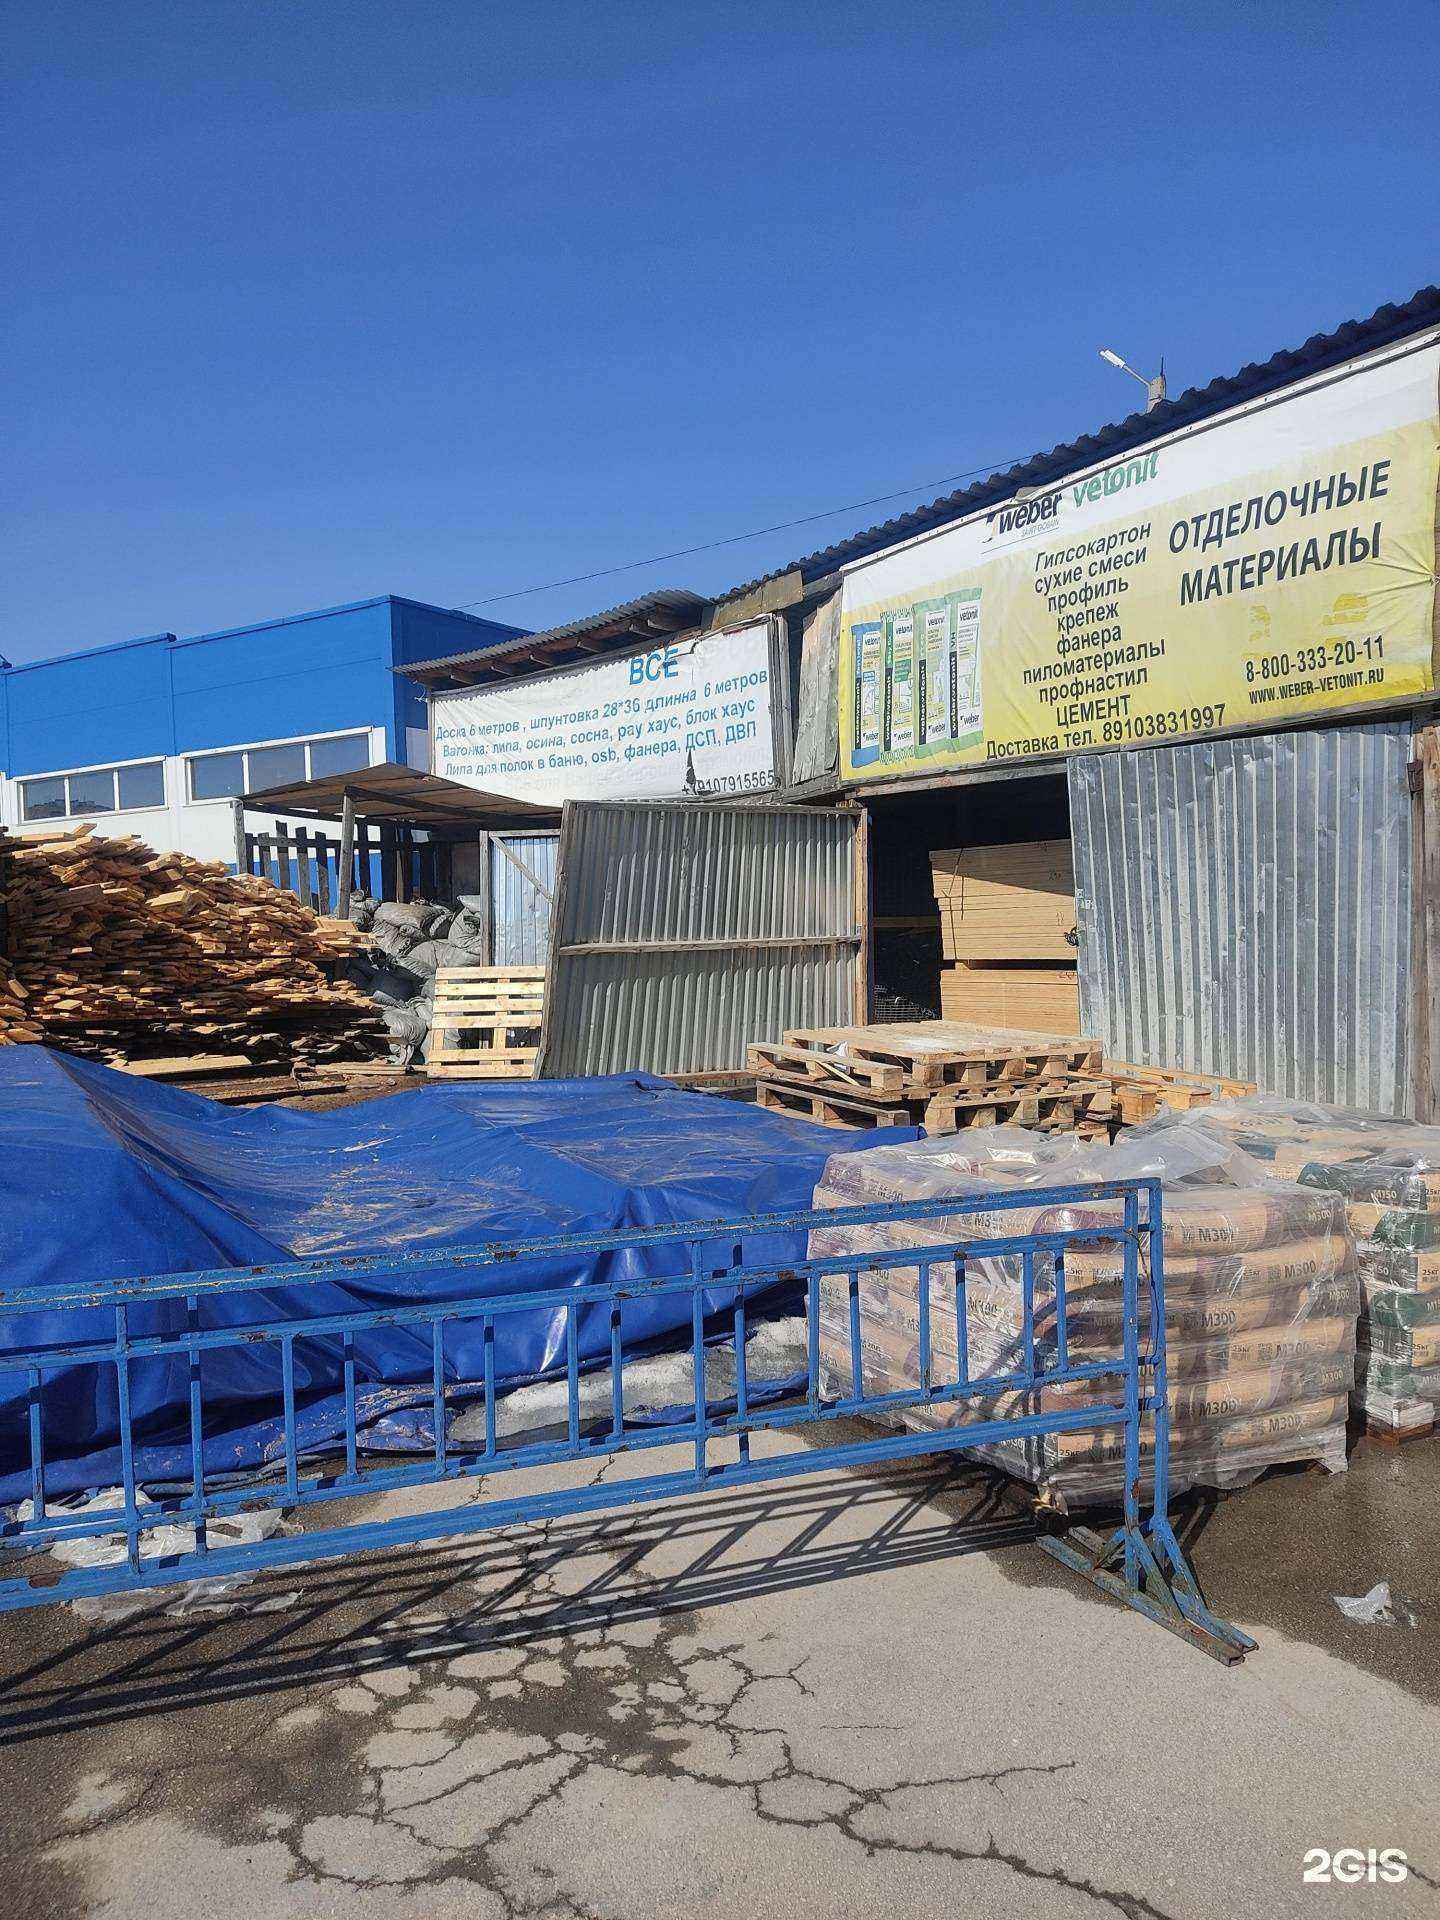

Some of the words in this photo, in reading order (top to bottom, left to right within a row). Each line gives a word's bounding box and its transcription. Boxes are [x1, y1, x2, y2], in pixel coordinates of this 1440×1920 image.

[1000, 493, 1062, 534] weber
[1073, 451, 1159, 507] vetonit
[1169, 460, 1391, 554] ОТДЕЛОЧНЫЕ
[1035, 522, 1151, 572] Гипсокартон
[1180, 521, 1382, 606] МАТЕРИАЛЫ
[1035, 566, 1082, 596] сухие
[1088, 547, 1147, 577] смеси
[1048, 577, 1129, 614] профиль
[1057, 601, 1119, 634] крепеж
[1024, 639, 1165, 684] пиломатериалы
[1057, 625, 1121, 658] фанера
[1246, 635, 1384, 682] 8-800-333-20-11
[629, 648, 679, 685] ВСЕ
[1039, 668, 1147, 706] профнастил
[1249, 668, 1384, 704] WWW.WEBER-VETONIT.RU
[436, 727, 466, 741] Доска
[470, 724, 476, 736] 6
[531, 708, 599, 732] шпунтовка
[645, 690, 697, 714] длинна
[704, 682, 711, 698] 6
[715, 670, 768, 695] метров
[571, 728, 613, 745] сосна,
[618, 724, 642, 741] рау
[648, 715, 681, 733] хаус,
[686, 708, 717, 725] блок
[722, 699, 756, 720] хаус
[1057, 695, 1131, 728] ЦЕМЕНТ
[500, 759, 533, 773] полок
[538, 758, 545, 769] в
[550, 754, 587, 769] баню,
[592, 747, 619, 764] osb,
[624, 739, 681, 762] фанера,
[686, 729, 721, 751] ДСП,
[725, 721, 756, 744] ДВП
[986, 735, 1059, 760] Доставка
[1064, 729, 1097, 748] тел.
[1103, 703, 1226, 742] 89103831997
